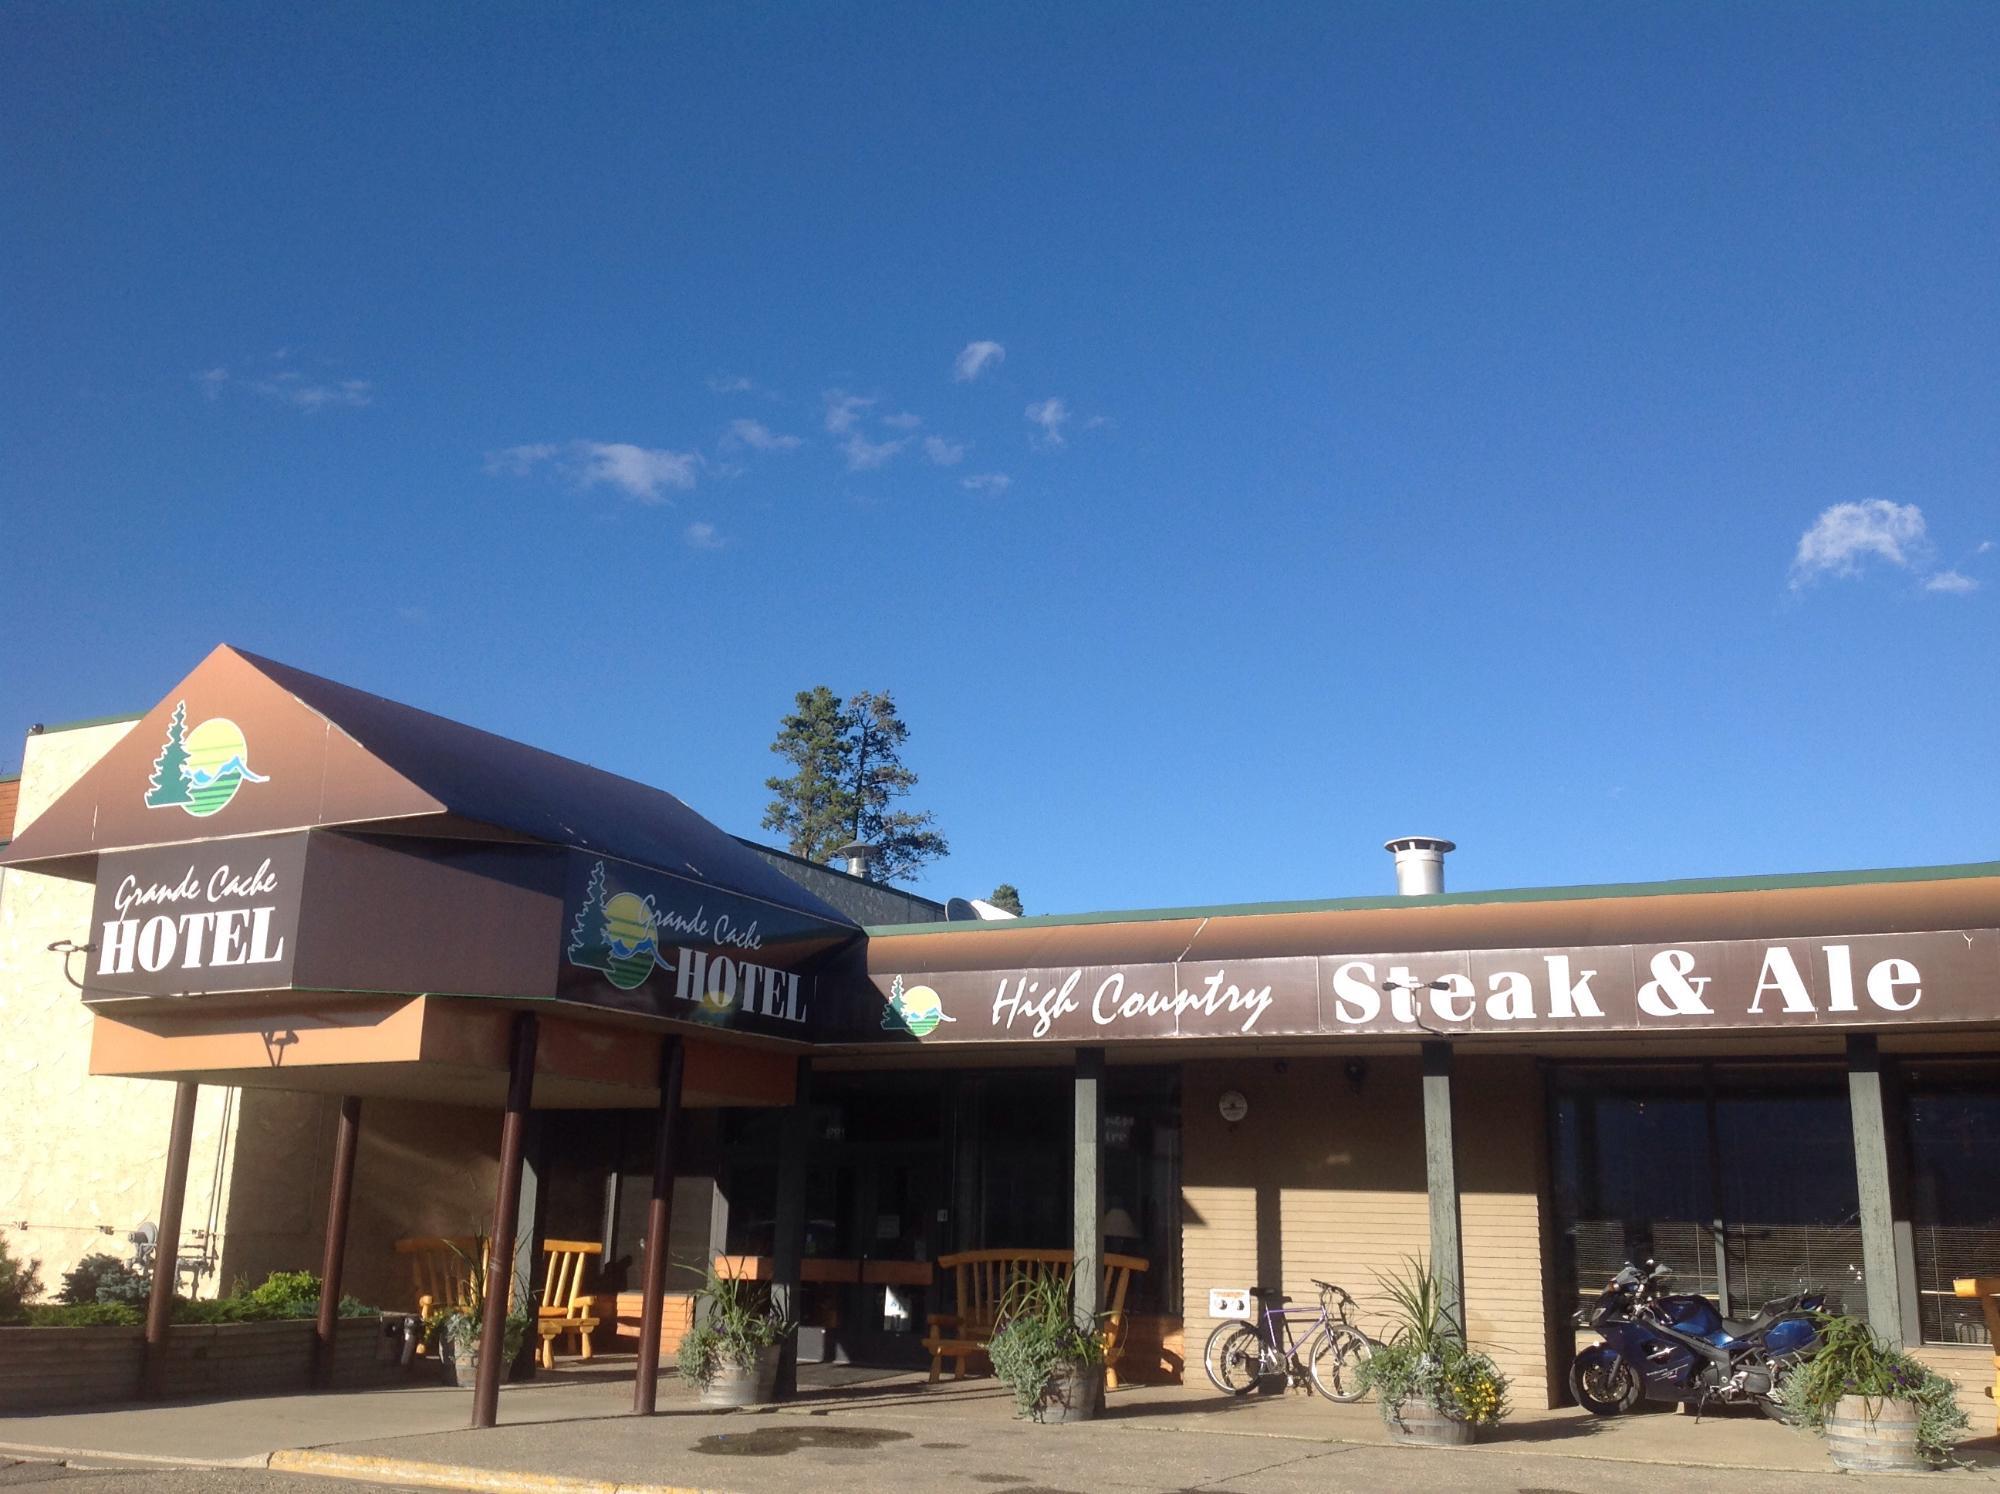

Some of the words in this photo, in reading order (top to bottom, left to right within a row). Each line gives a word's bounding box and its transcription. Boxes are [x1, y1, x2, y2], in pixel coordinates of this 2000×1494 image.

[114, 865, 201, 921] Grande
[206, 857, 278, 903] Cache
[639, 894, 708, 943] Grande
[714, 914, 763, 950] Cache
[96, 906, 284, 975] HOTEL
[674, 946, 807, 1023] HOTEL
[991, 968, 1082, 1037] High
[1092, 969, 1273, 1032] Country
[1332, 955, 1605, 1023] Steak
[1636, 949, 1715, 1016] &
[1747, 944, 1923, 1014] Ale
